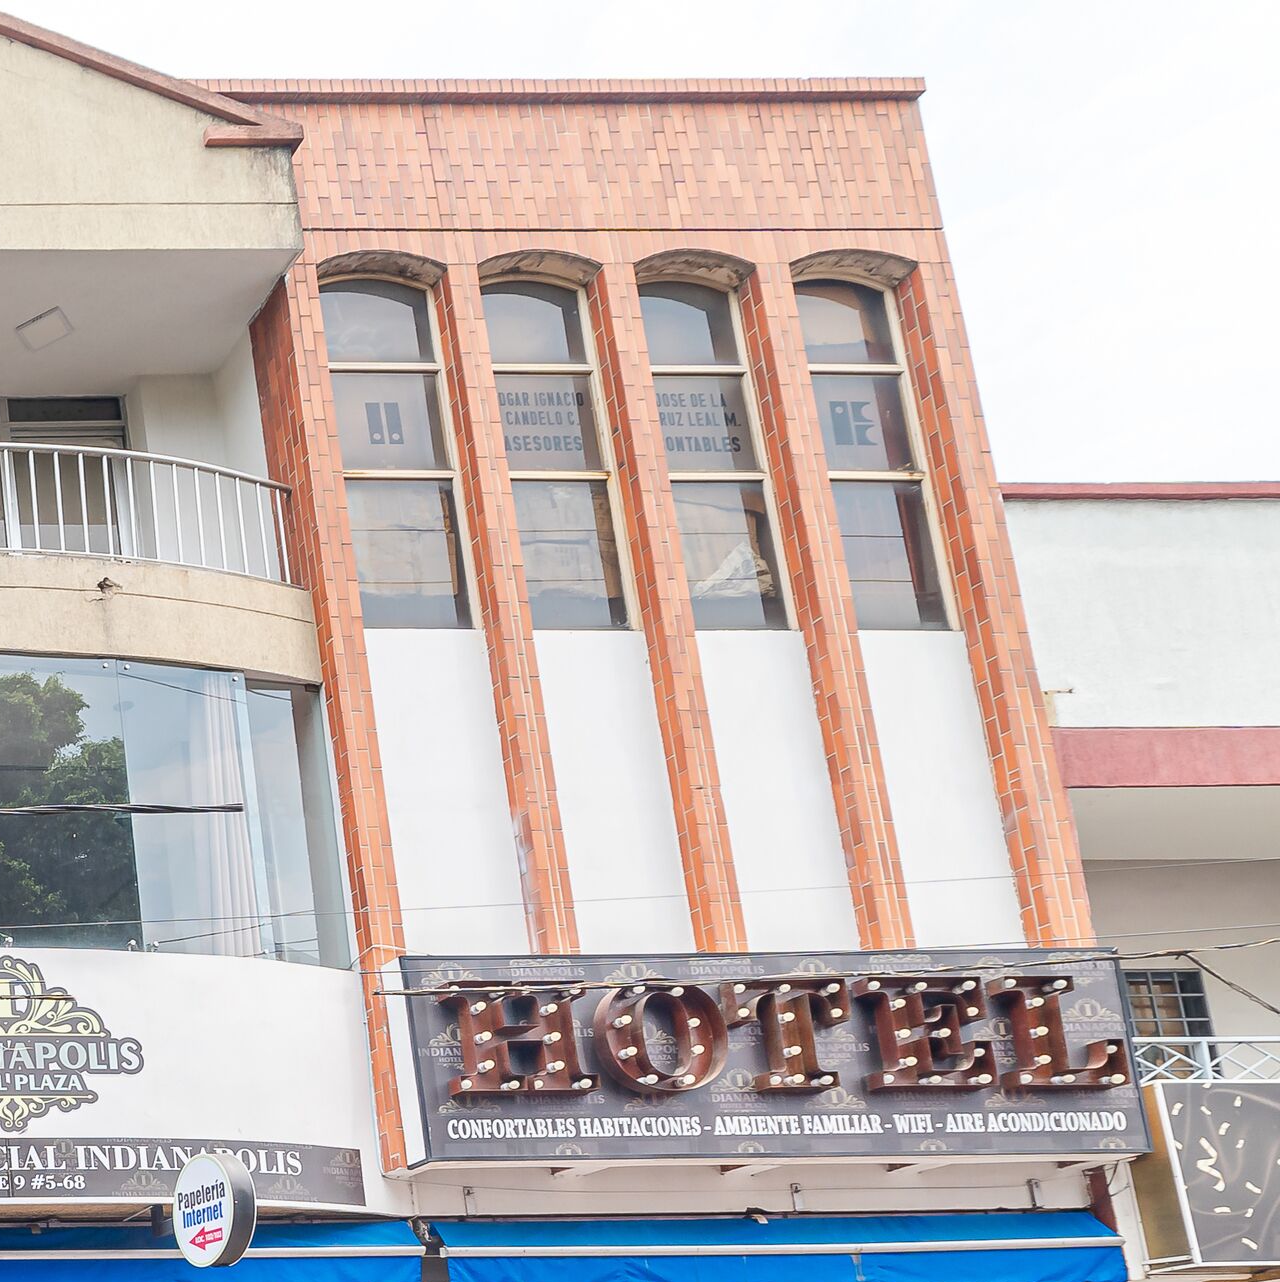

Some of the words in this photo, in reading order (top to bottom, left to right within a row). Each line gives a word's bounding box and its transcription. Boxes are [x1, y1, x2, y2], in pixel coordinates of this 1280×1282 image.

[497, 392, 530, 407] DGAR
[534, 392, 584, 407] IGNACIO
[690, 393, 708, 408] DE
[709, 393, 727, 408] LA
[506, 411, 563, 426] CANDELO
[660, 411, 683, 427] RUZ
[689, 411, 721, 427] LEAL
[504, 435, 583, 452] ASESORES
[665, 436, 742, 453] ONTABLES
[438, 976, 1129, 1099] HOTEL
[15, 1074, 84, 1092] PLAZA
[446, 1117, 577, 1140] CONFORTABLES
[580, 1115, 703, 1139] HABITACIONES
[713, 1114, 801, 1137] AMBIENTE
[803, 1113, 883, 1136] FAMILIAR
[893, 1112, 934, 1134] WIFI
[945, 1112, 985, 1133] AIRE
[987, 1111, 1127, 1133] ACONDICIONADO
[75, 1145, 303, 1176] INDIANOLIS
[14, 1175, 26, 1190] 9
[30, 1174, 86, 1190] #5-68
[177, 1178, 226, 1211] Papelería
[182, 1200, 224, 1229] Internet
